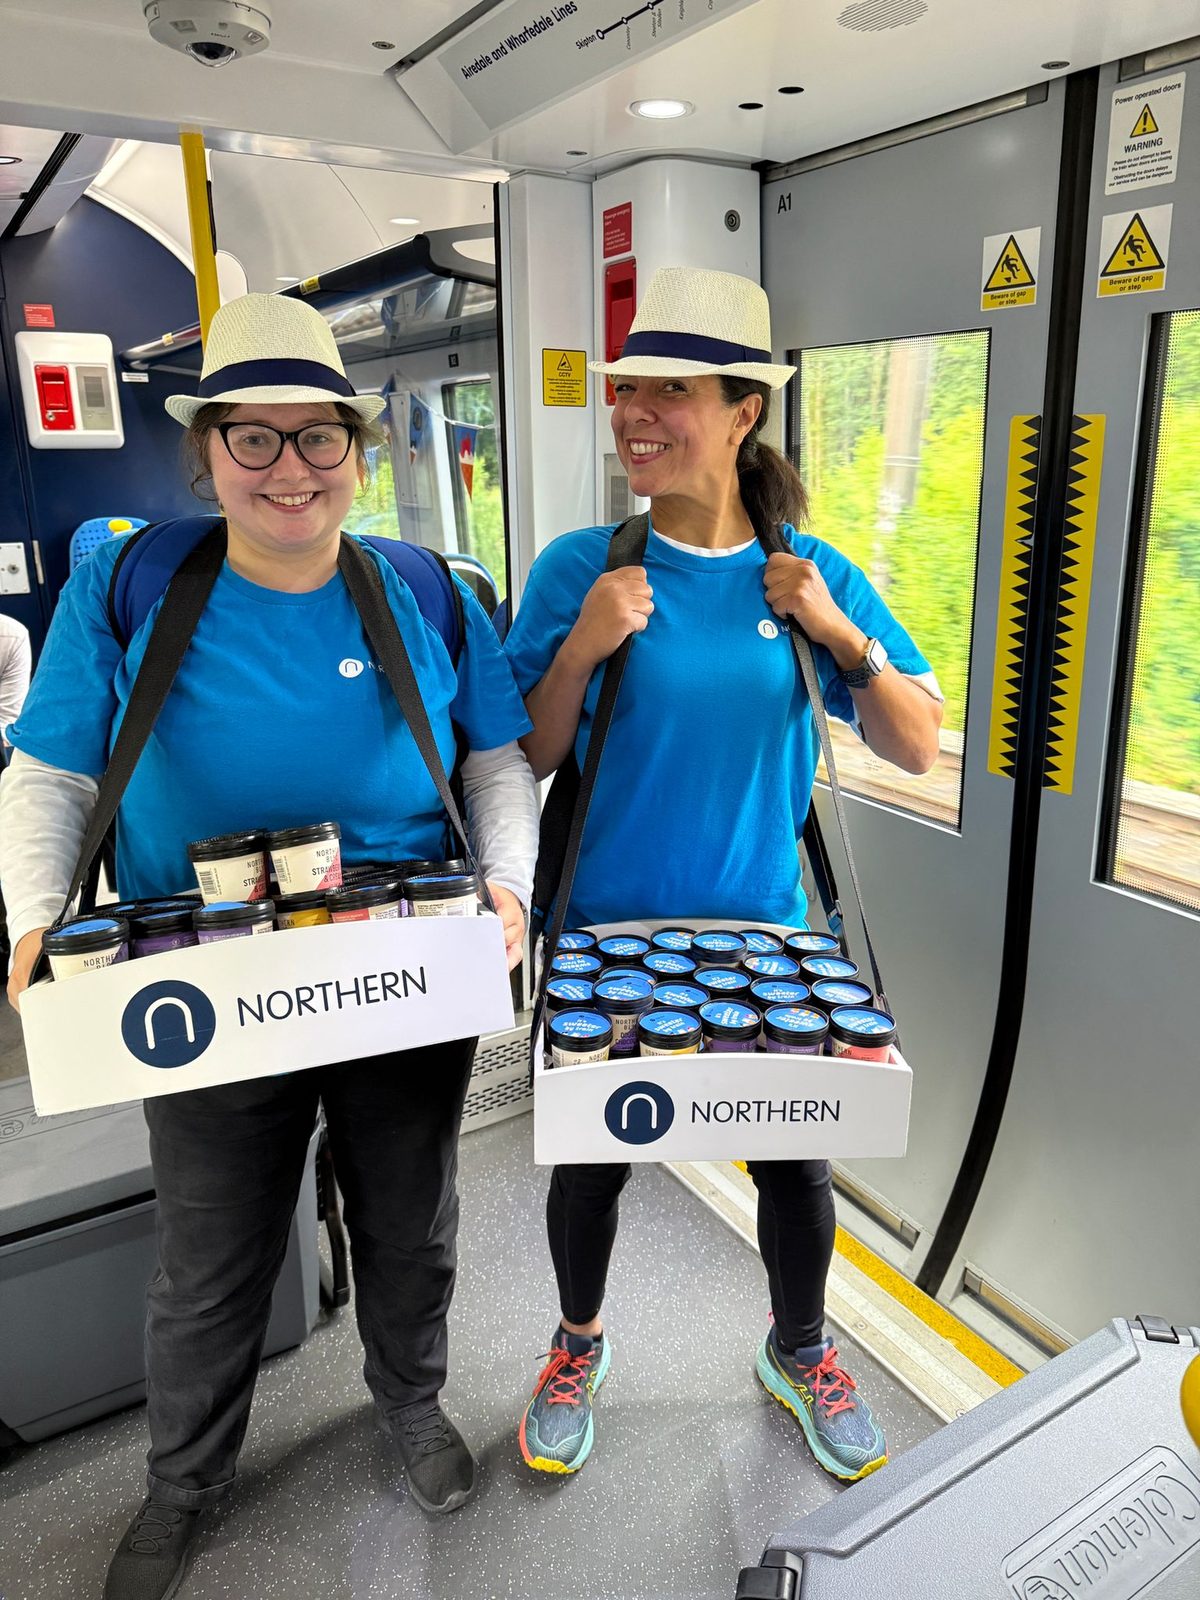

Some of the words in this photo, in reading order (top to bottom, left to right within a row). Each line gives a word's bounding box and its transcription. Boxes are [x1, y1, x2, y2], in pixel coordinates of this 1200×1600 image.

[461, 54, 493, 79] Airedale
[491, 42, 508, 61] and
[504, 16, 554, 51] Wharfedale
[551, 1, 578, 23] Lines
[575, 34, 597, 49] Skipton
[1115, 95, 1133, 105] Power
[1135, 87, 1162, 100] operated
[1163, 83, 1182, 92] doors
[1124, 138, 1163, 153] WARNING
[777, 191, 792, 214] A1
[237, 966, 427, 1027] NORTHERN
[691, 1100, 840, 1123] NORTHERN
